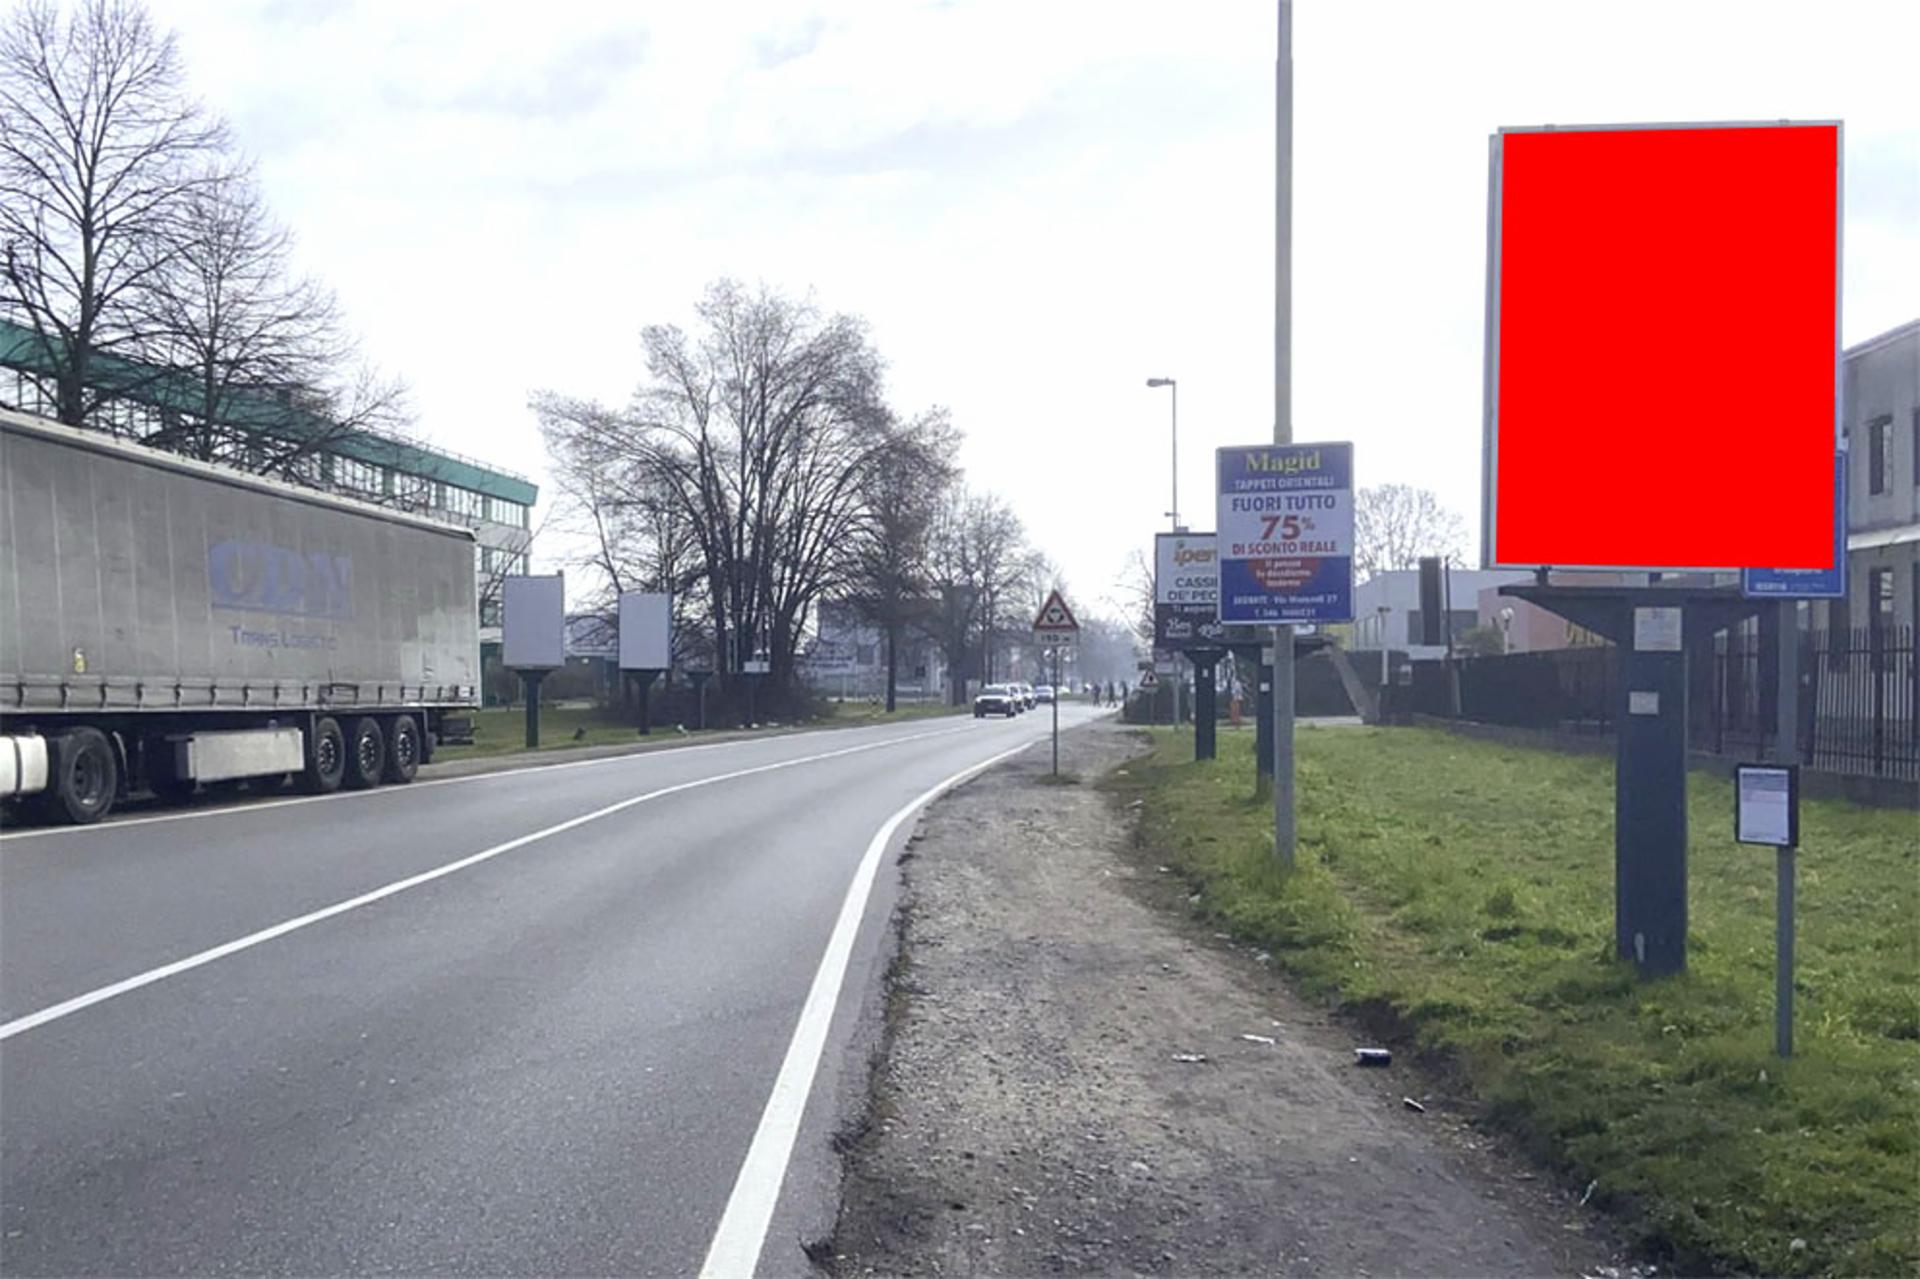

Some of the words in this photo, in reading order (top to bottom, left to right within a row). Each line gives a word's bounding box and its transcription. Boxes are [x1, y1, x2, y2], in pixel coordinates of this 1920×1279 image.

[1245, 450, 1320, 474] Magid
[1232, 496, 1281, 512] FUORI
[1286, 494, 1336, 510] TUTTO
[1232, 543, 1246, 555] DI
[1248, 541, 1297, 555] SCONTO
[1300, 540, 1336, 553] REALE
[1175, 577, 1218, 588] CASSI
